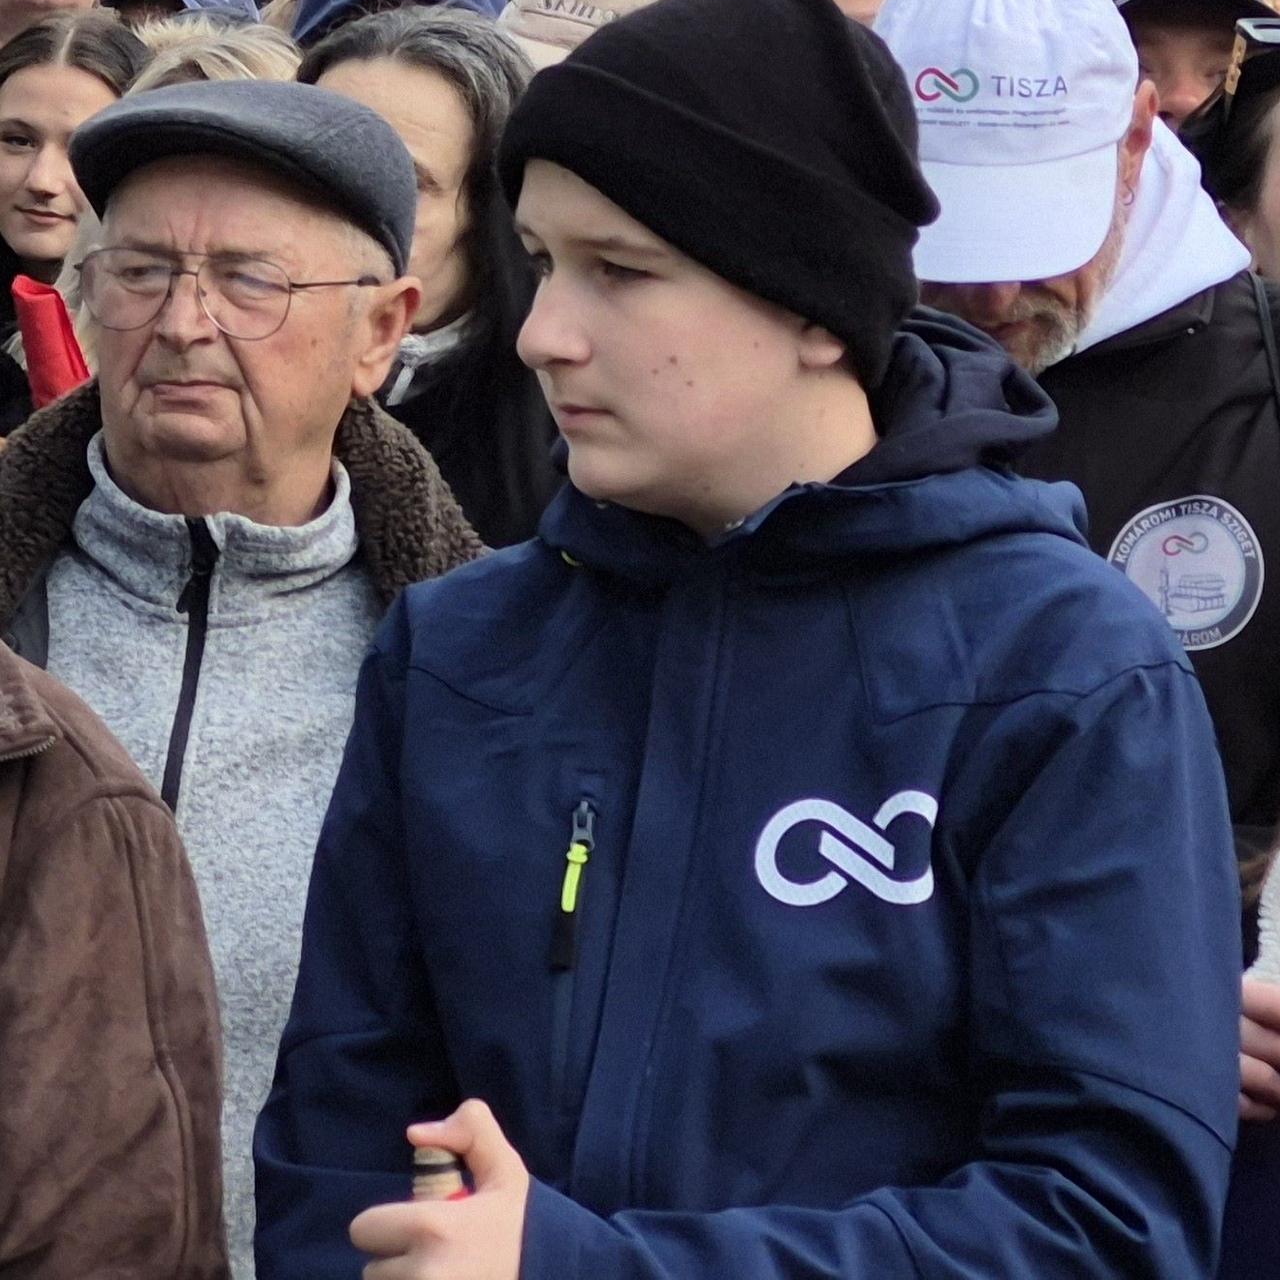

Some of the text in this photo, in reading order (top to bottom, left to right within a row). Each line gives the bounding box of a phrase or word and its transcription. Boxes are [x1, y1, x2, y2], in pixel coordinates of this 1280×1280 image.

[991, 75, 1069, 98] TISZA
[1114, 501, 1256, 564] KOMÁROMI TISZA SZIGET
